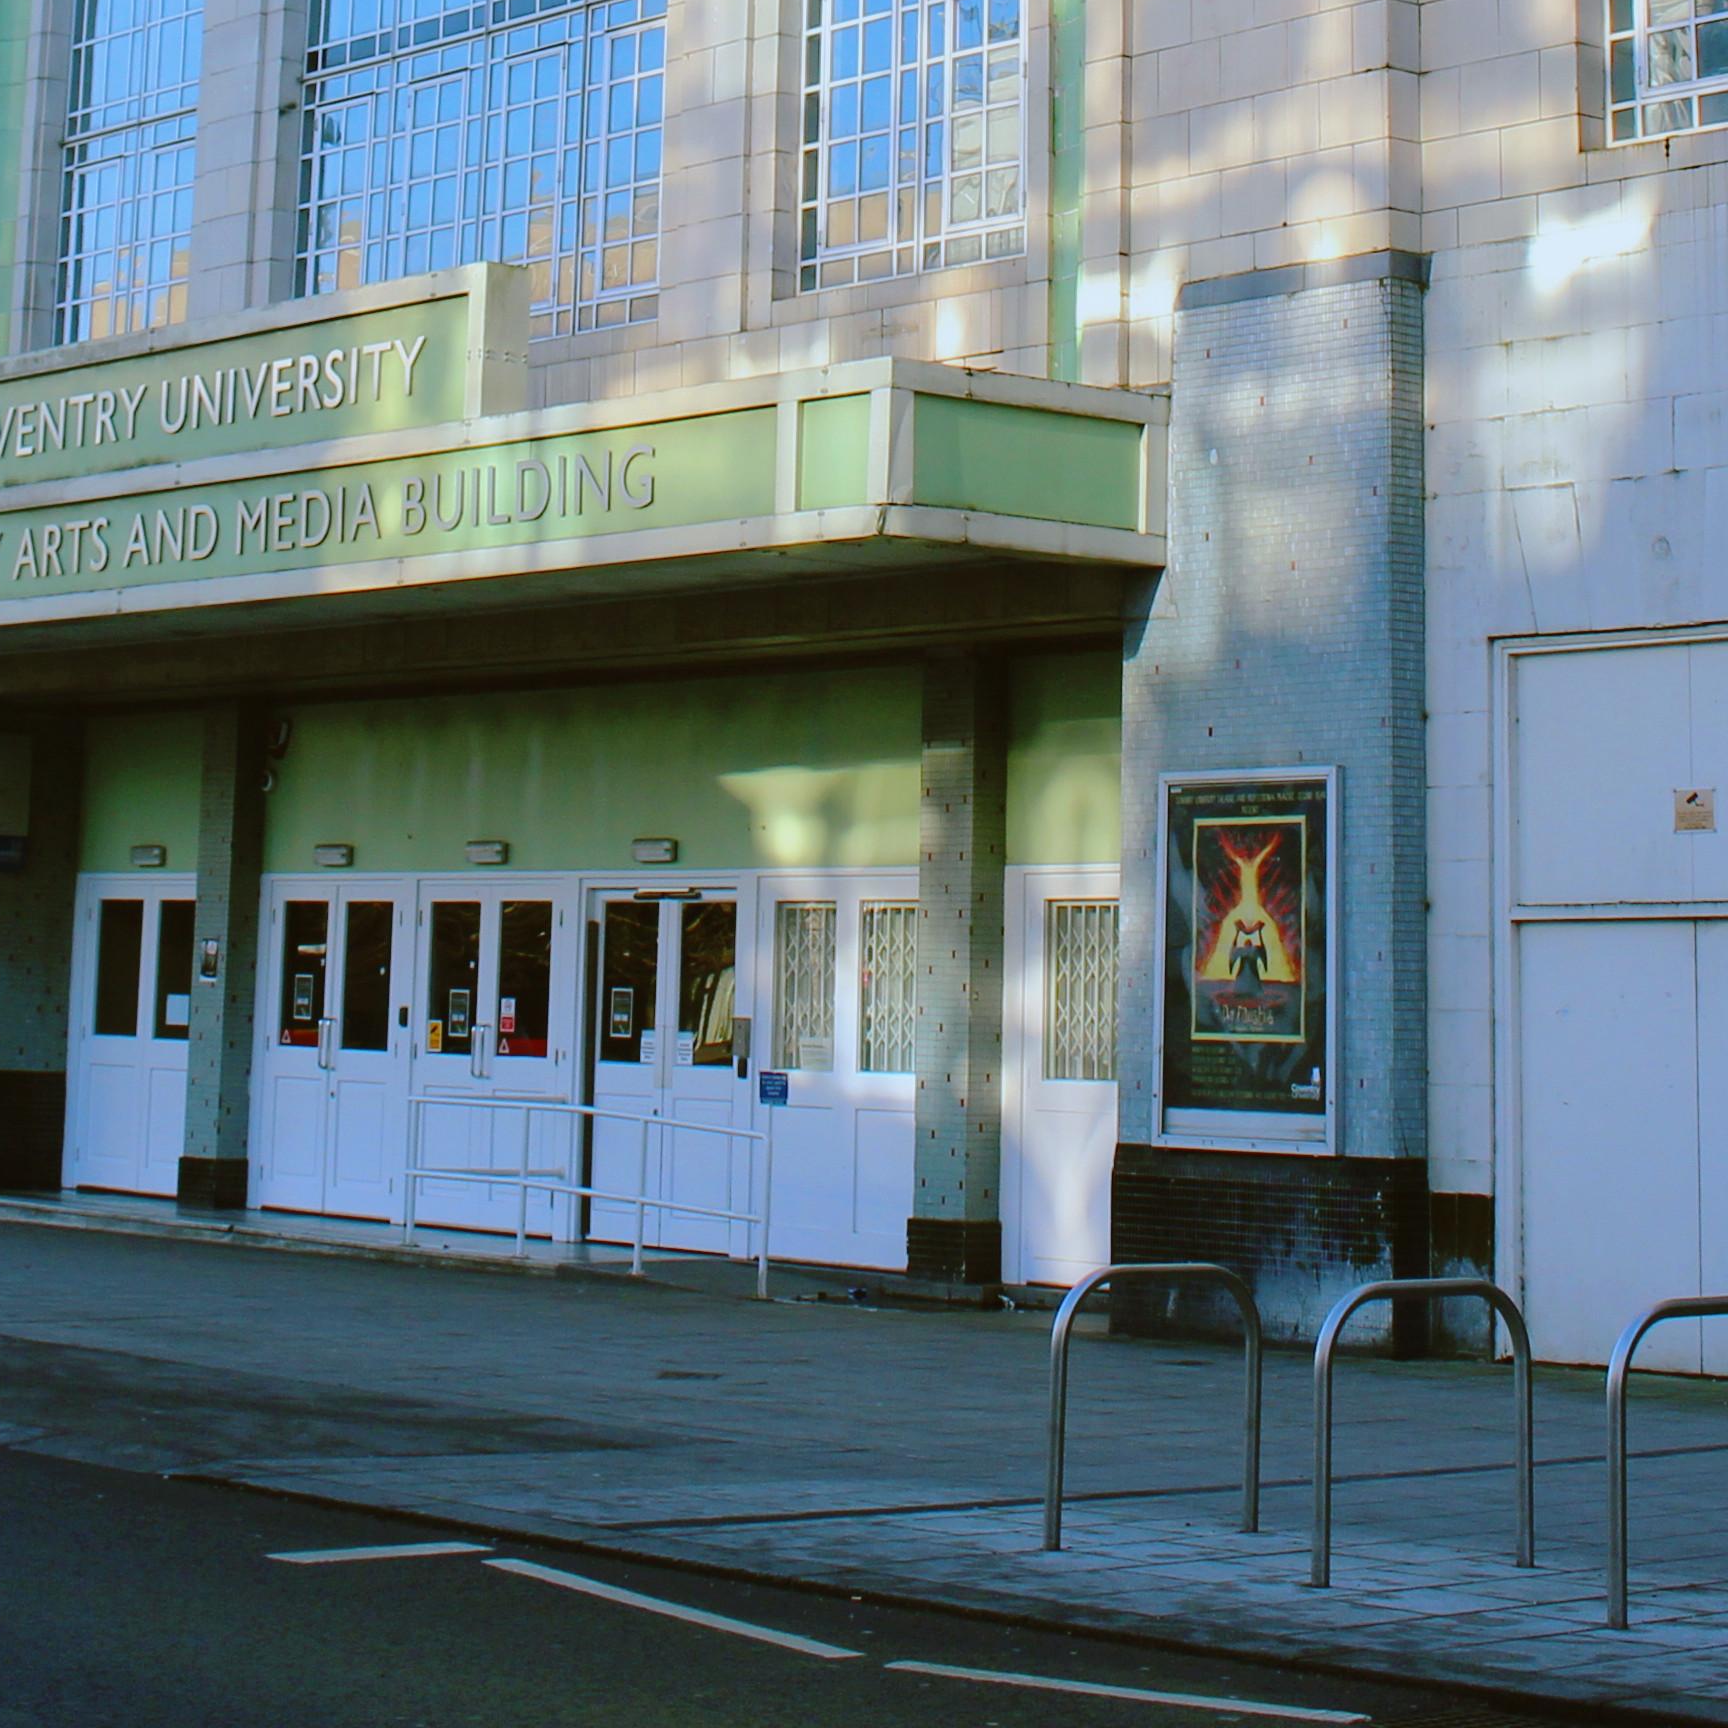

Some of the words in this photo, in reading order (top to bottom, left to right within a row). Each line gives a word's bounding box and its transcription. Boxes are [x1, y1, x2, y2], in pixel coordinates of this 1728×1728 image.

[159, 335, 428, 435] UNIVERSITY
[11, 515, 109, 580] ARTS
[123, 502, 219, 569] AND
[235, 482, 382, 556] MEDIA
[399, 442, 658, 536] BUILDING
